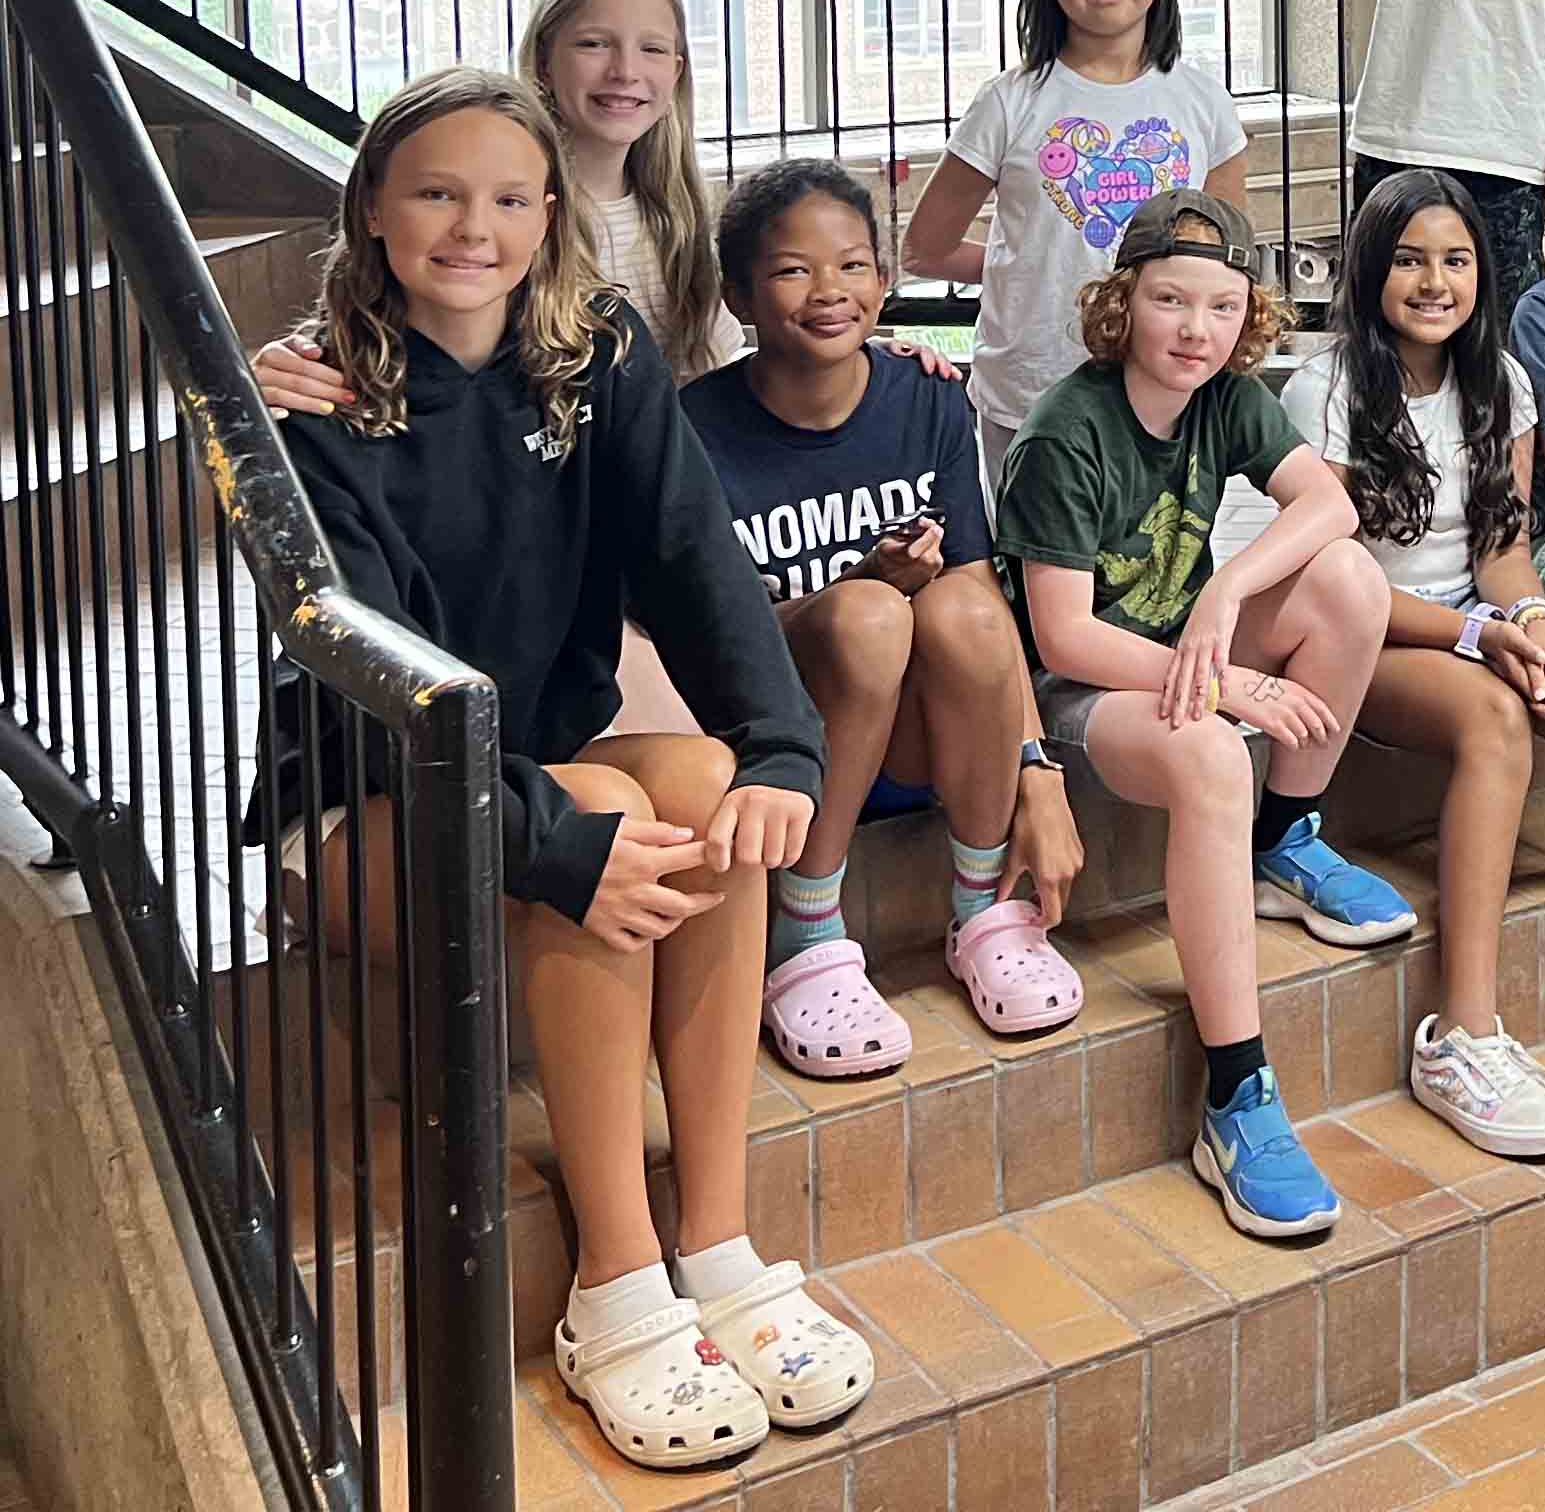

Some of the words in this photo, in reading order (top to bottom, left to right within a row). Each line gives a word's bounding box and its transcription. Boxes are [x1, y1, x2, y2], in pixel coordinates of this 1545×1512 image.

[1124, 117, 1171, 139] COOL
[1097, 170, 1140, 186] GIRL
[1041, 179, 1086, 231] STRONG
[1086, 183, 1152, 206] POWER
